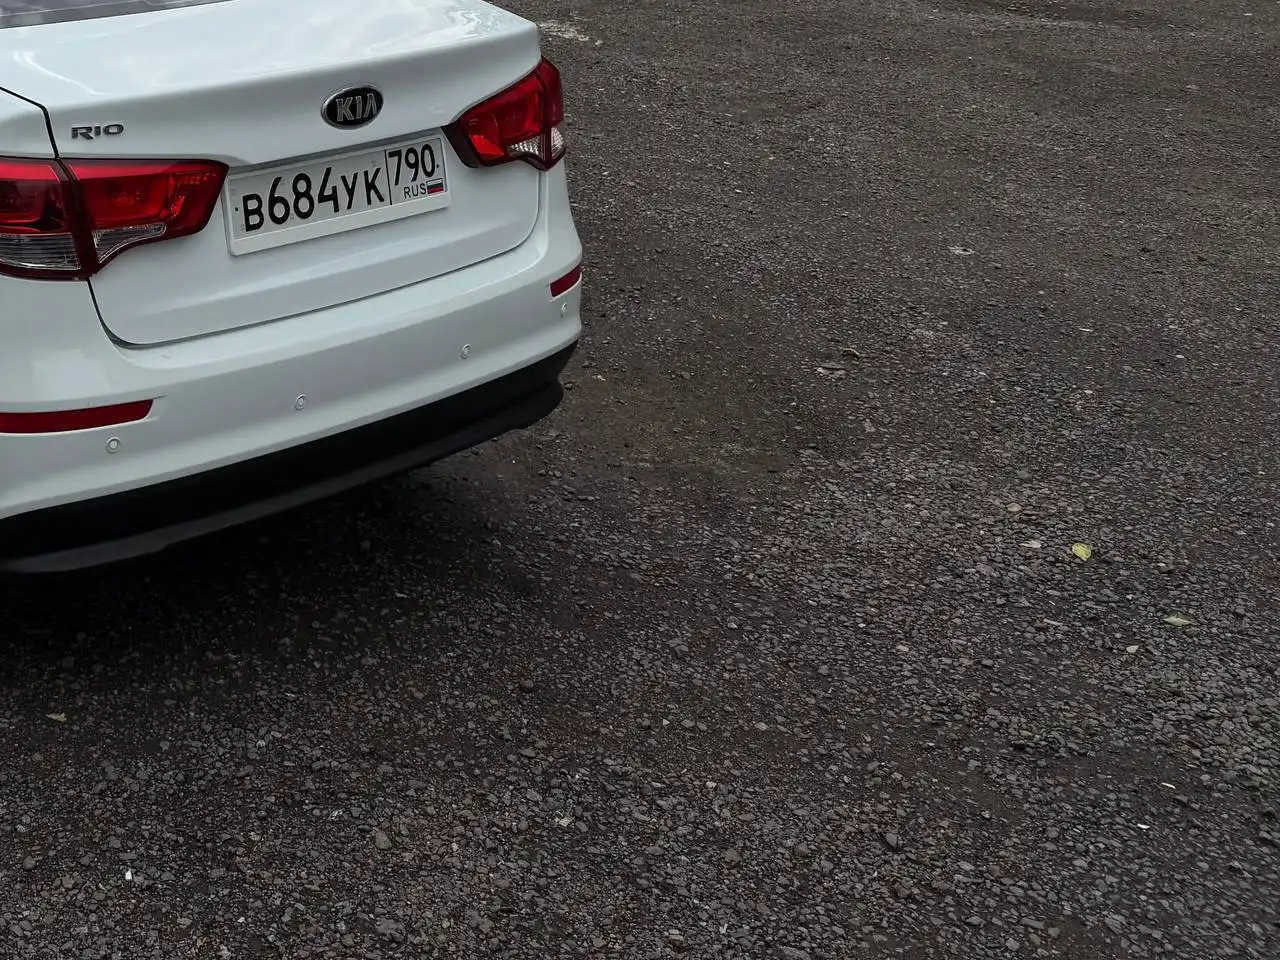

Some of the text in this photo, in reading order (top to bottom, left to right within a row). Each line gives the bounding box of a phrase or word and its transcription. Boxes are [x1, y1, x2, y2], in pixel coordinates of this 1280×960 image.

[335, 92, 378, 122] KIA
[71, 123, 125, 141] RIO
[388, 143, 436, 187] 790
[403, 182, 427, 200] RUS
